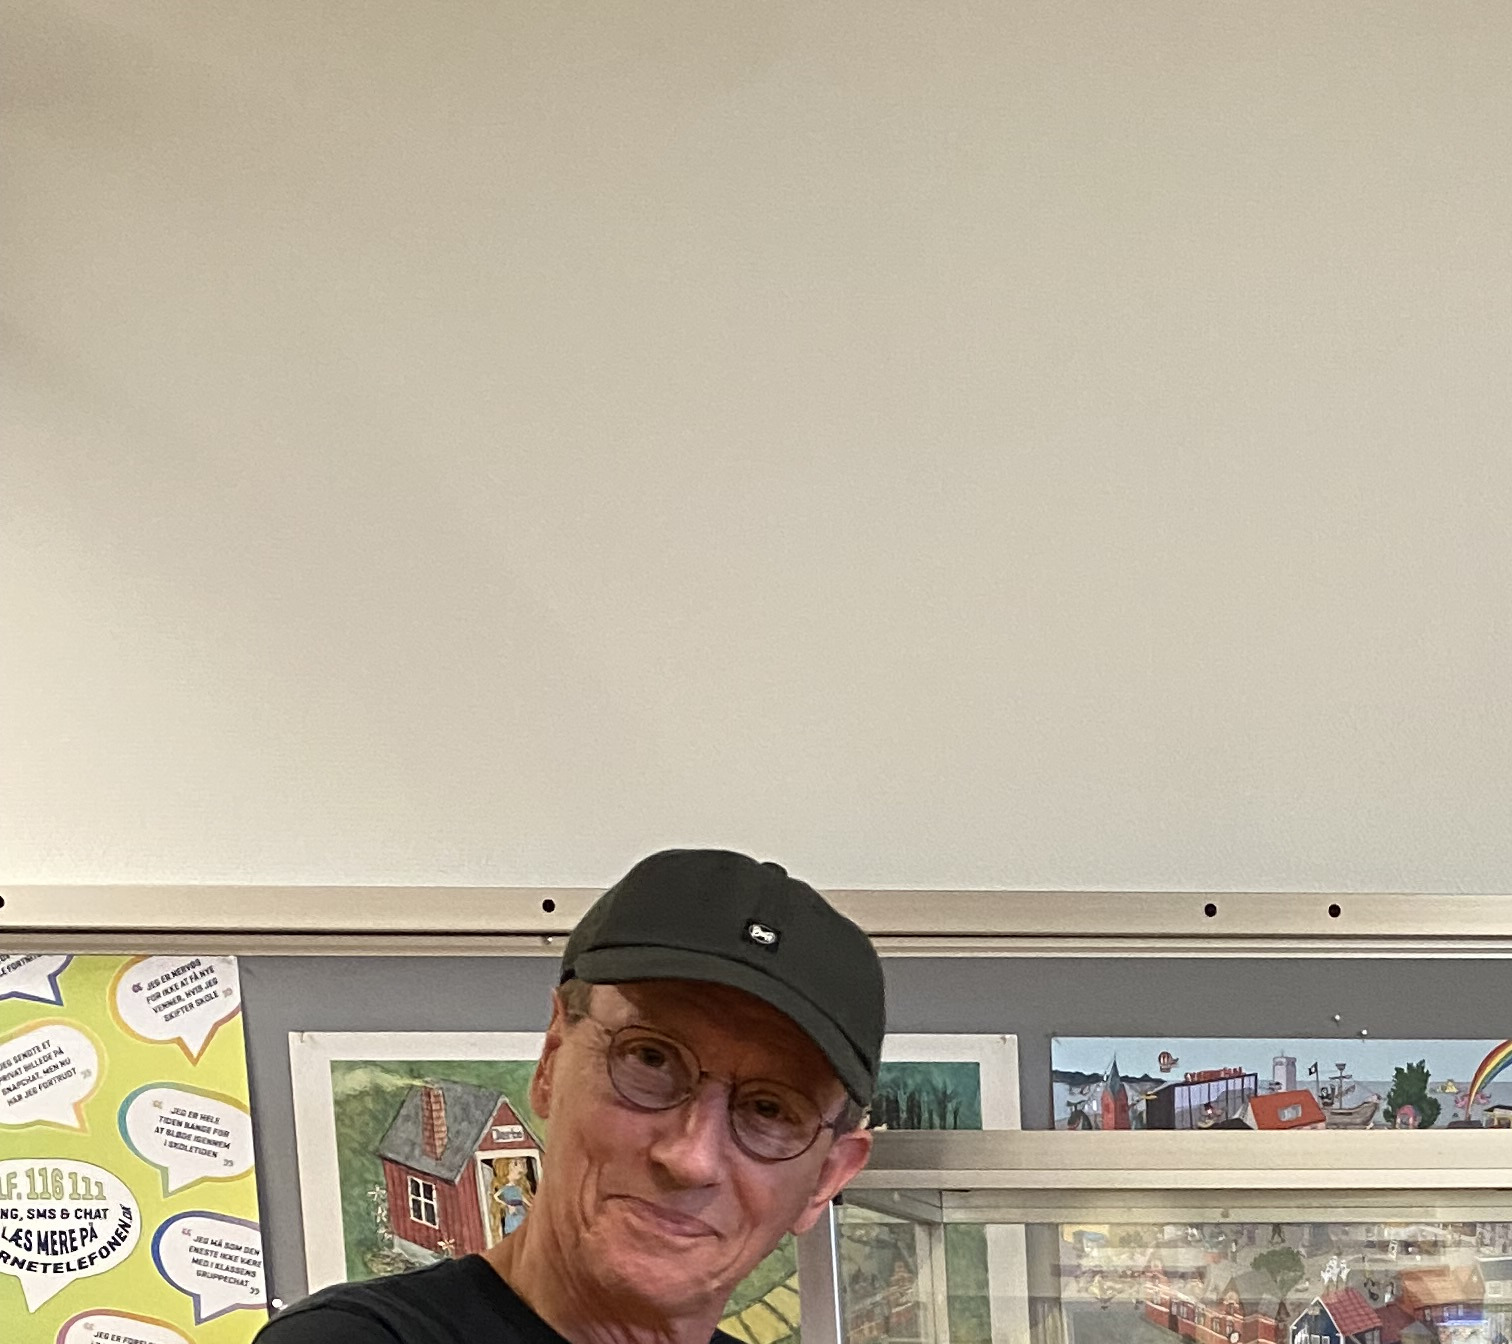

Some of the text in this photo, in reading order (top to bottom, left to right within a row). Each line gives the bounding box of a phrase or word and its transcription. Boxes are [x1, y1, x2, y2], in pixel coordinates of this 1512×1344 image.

[146, 965, 215, 1004] FOR IKKE AT FÅ NYE
[147, 979, 160, 990] JEG
[161, 973, 171, 983] ER
[185, 985, 204, 998] HVIS
[205, 977, 218, 989] JEG
[163, 990, 219, 1021] SKIFTER SKOLE
[13, 1046, 41, 1063] SENDTE
[42, 1040, 51, 1049] ET
[23, 1053, 52, 1071] BILLEDE
[53, 1046, 64, 1057] PÅ
[43, 1064, 59, 1075] MEN
[59, 1057, 71, 1067] NU
[7, 1067, 76, 1106] HAR JEG FORTRUDT
[171, 1107, 186, 1116] JEG
[188, 1111, 198, 1119] ER
[154, 1126, 164, 1134] AT
[159, 1116, 183, 1127] TIDEN
[213, 1128, 230, 1137] FOR
[25, 1167, 64, 1200] 116
[68, 1172, 107, 1200] 111
[27, 1208, 56, 1219] SMS
[60, 1208, 70, 1219] &
[74, 1208, 109, 1220] CHAT
[1, 1222, 98, 1256] LÆS MERE PÅ
[193, 1236, 260, 1256] JEG MÅ SOM DEN
[191, 1256, 209, 1267] MED
[220, 1253, 239, 1262] IKKE
[93, 1331, 109, 1340] JEG
[111, 1334, 121, 1342] ER
